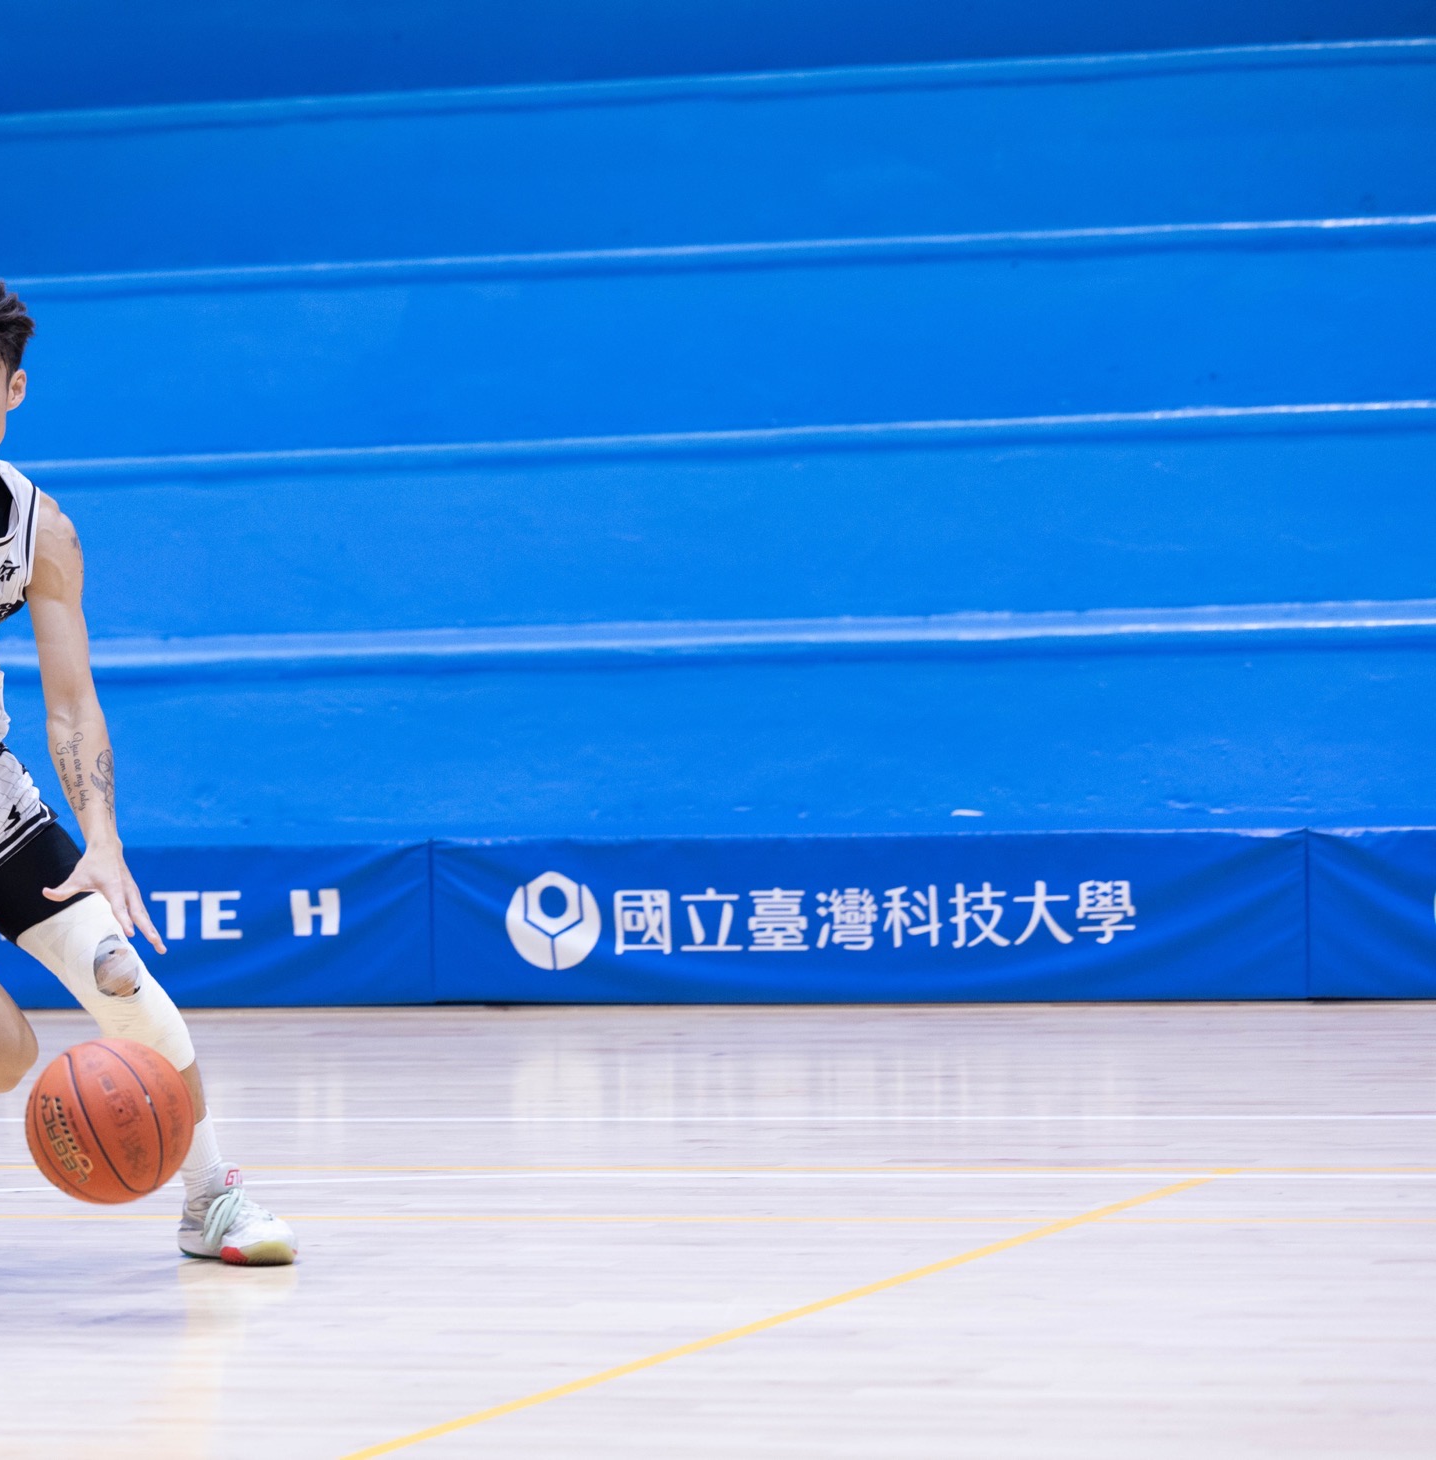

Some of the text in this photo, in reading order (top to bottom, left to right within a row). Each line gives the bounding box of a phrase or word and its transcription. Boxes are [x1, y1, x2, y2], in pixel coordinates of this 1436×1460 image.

[613, 878, 1138, 956] 國立臺灣科技大學
[40, 1094, 90, 1184] LEGACY
